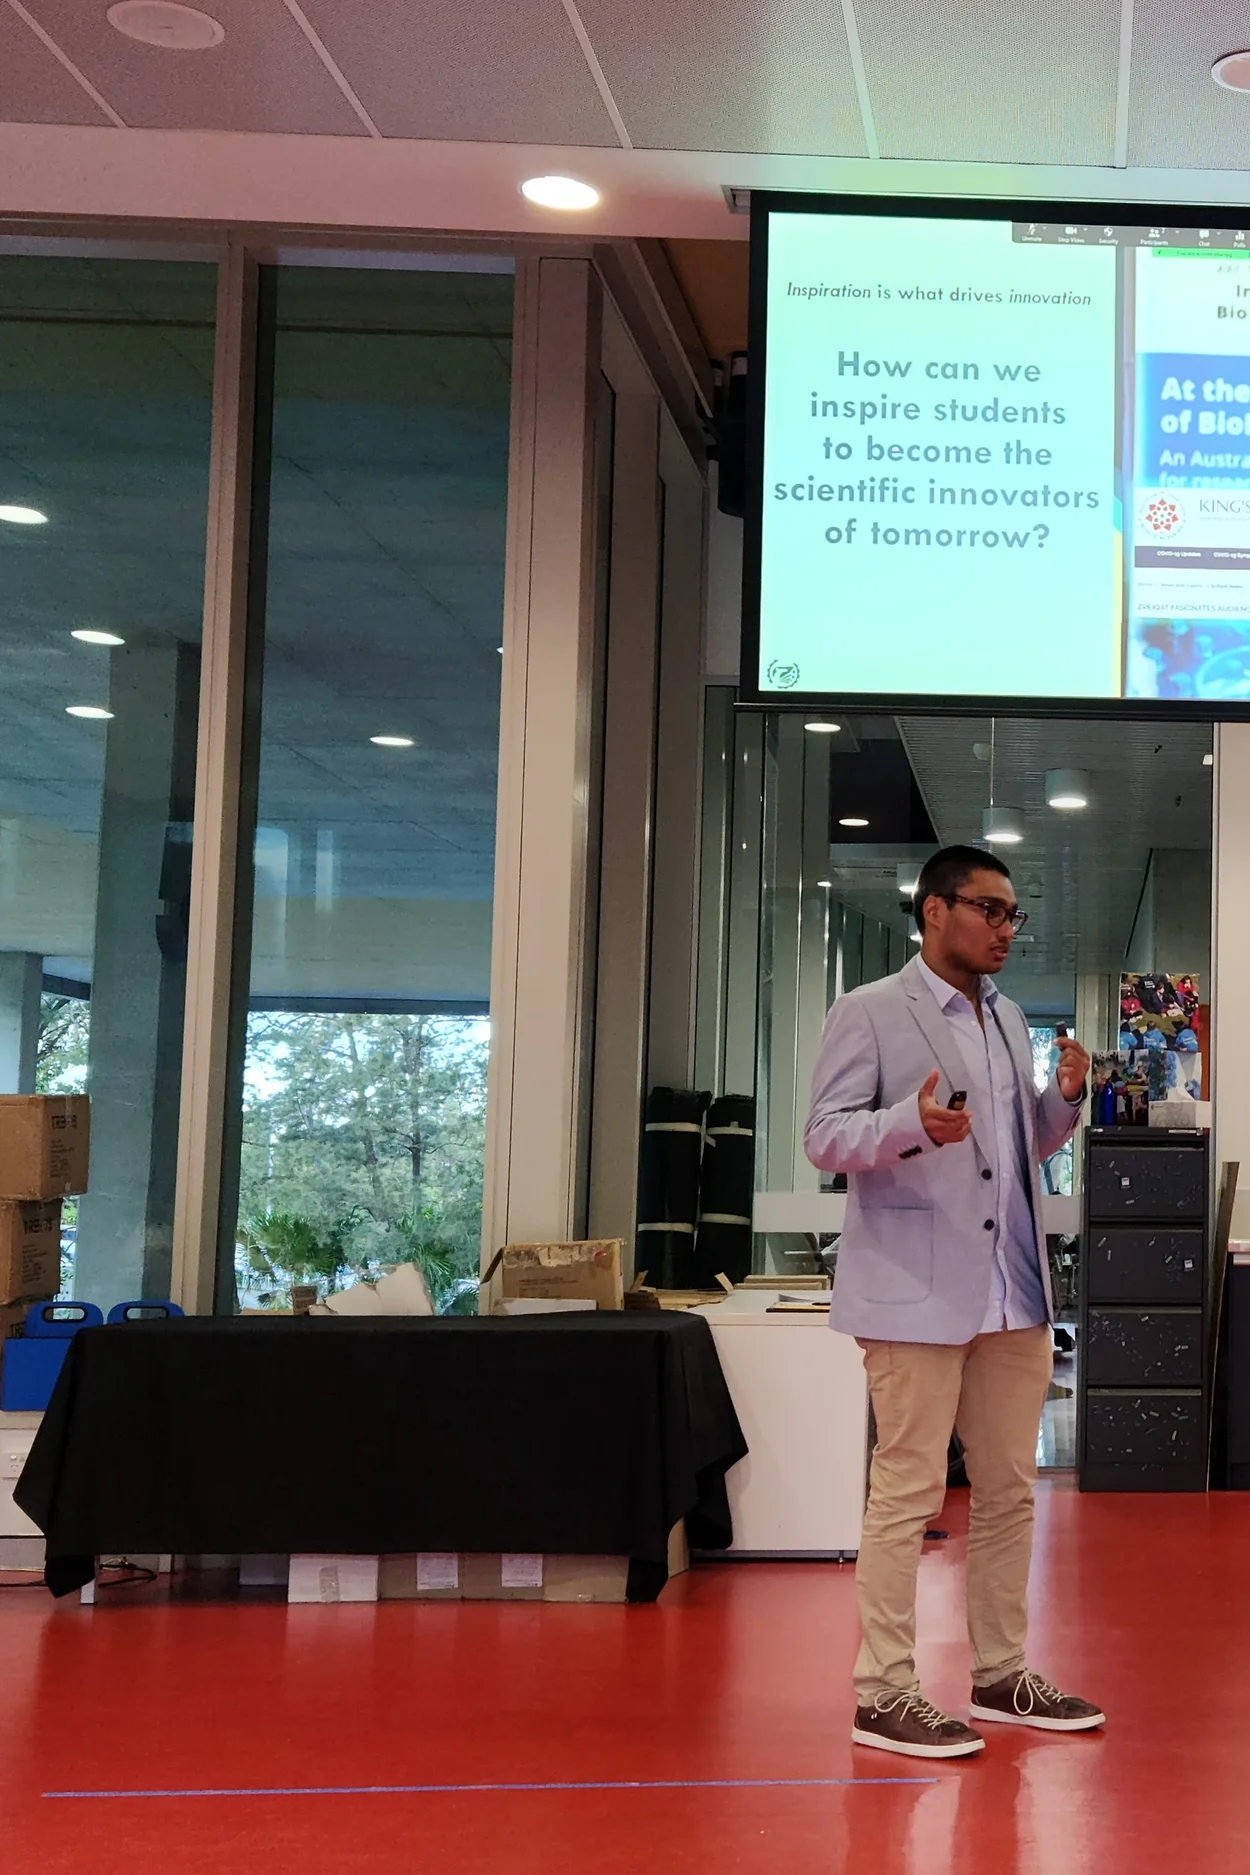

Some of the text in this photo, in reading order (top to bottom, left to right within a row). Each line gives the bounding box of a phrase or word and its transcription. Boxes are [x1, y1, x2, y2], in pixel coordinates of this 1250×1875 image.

[787, 282, 1092, 306] Inspiration is what drives innovation
[838, 351, 1041, 382] How can we
[1161, 377, 1196, 401] At
[810, 392, 1067, 425] inspire students
[1161, 409, 1192, 434] of
[823, 435, 1053, 466] to become the
[1159, 449, 1186, 467] An
[773, 475, 1100, 509] scientific innovators
[1159, 471, 1188, 488] for
[824, 518, 1050, 549] of tomorrow?
